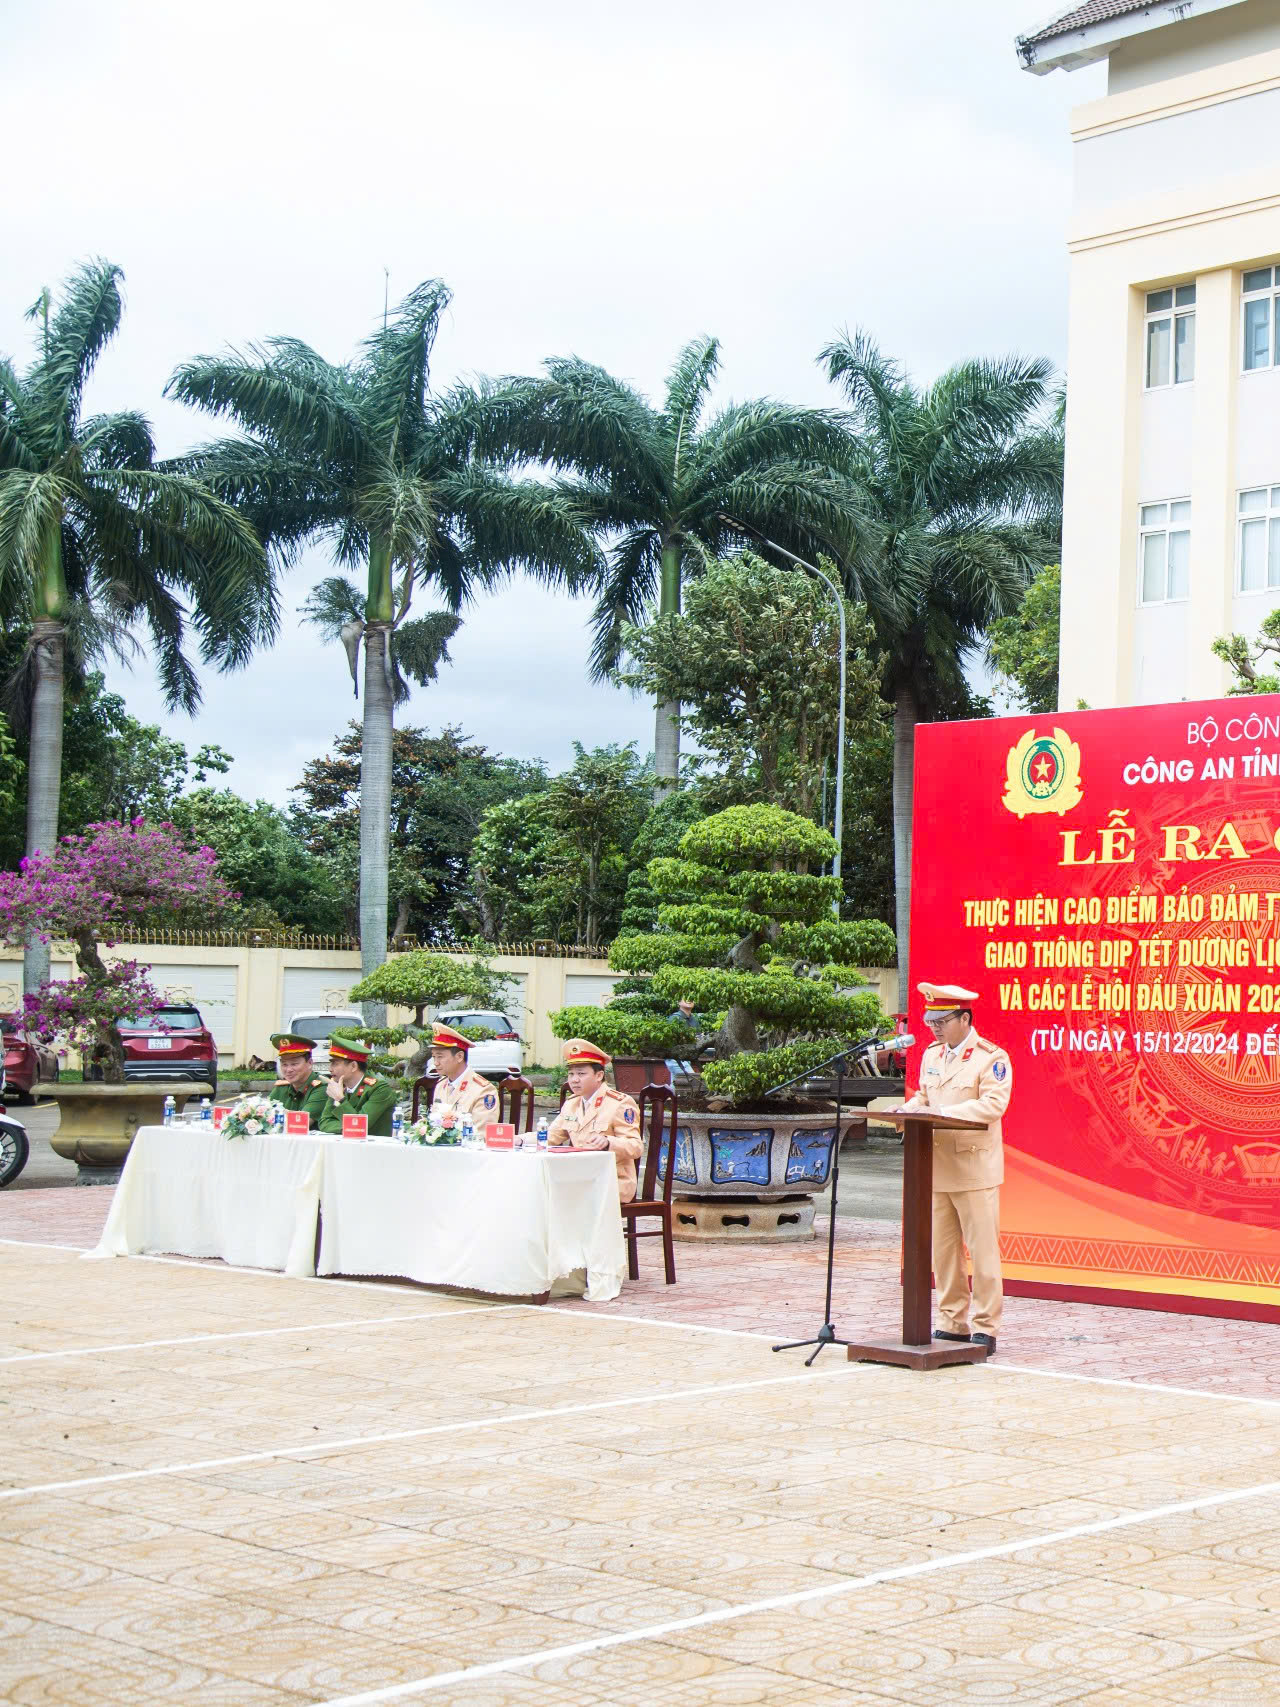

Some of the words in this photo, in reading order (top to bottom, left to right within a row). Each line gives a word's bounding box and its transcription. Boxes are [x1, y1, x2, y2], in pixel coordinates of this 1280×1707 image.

[1187, 716, 1219, 747] BỘ
[1123, 756, 1195, 785] CÔNG
[1200, 757, 1234, 781] AN
[1058, 808, 1136, 866] LỄ
[1159, 822, 1251, 862] RA
[964, 897, 1010, 934] THỰC
[1015, 893, 1059, 931] HIỆN
[1064, 896, 1101, 925] CAO
[1106, 885, 1157, 925] ĐIỂM
[1164, 886, 1204, 923] BẢO
[1210, 884, 1259, 922] ĐẢM
[985, 940, 1027, 968] GIAO
[1032, 935, 1094, 968] THÔNG
[1101, 940, 1133, 973] DỊP
[1139, 931, 1173, 967] TẾT
[1178, 936, 1249, 967] DƯƠNG
[1000, 978, 1023, 1011] VÀ
[1028, 976, 1065, 1011] CÁC
[1072, 973, 1093, 1010] LỄ
[1099, 978, 1130, 1017] HỘI
[1137, 974, 1178, 1011] ĐẦU
[1184, 978, 1241, 1012] XUÂN
[1031, 1026, 1064, 1056] (TỪ
[1071, 1025, 1126, 1053] NGÀY
[1132, 1031, 1240, 1055] 15/12/2024
